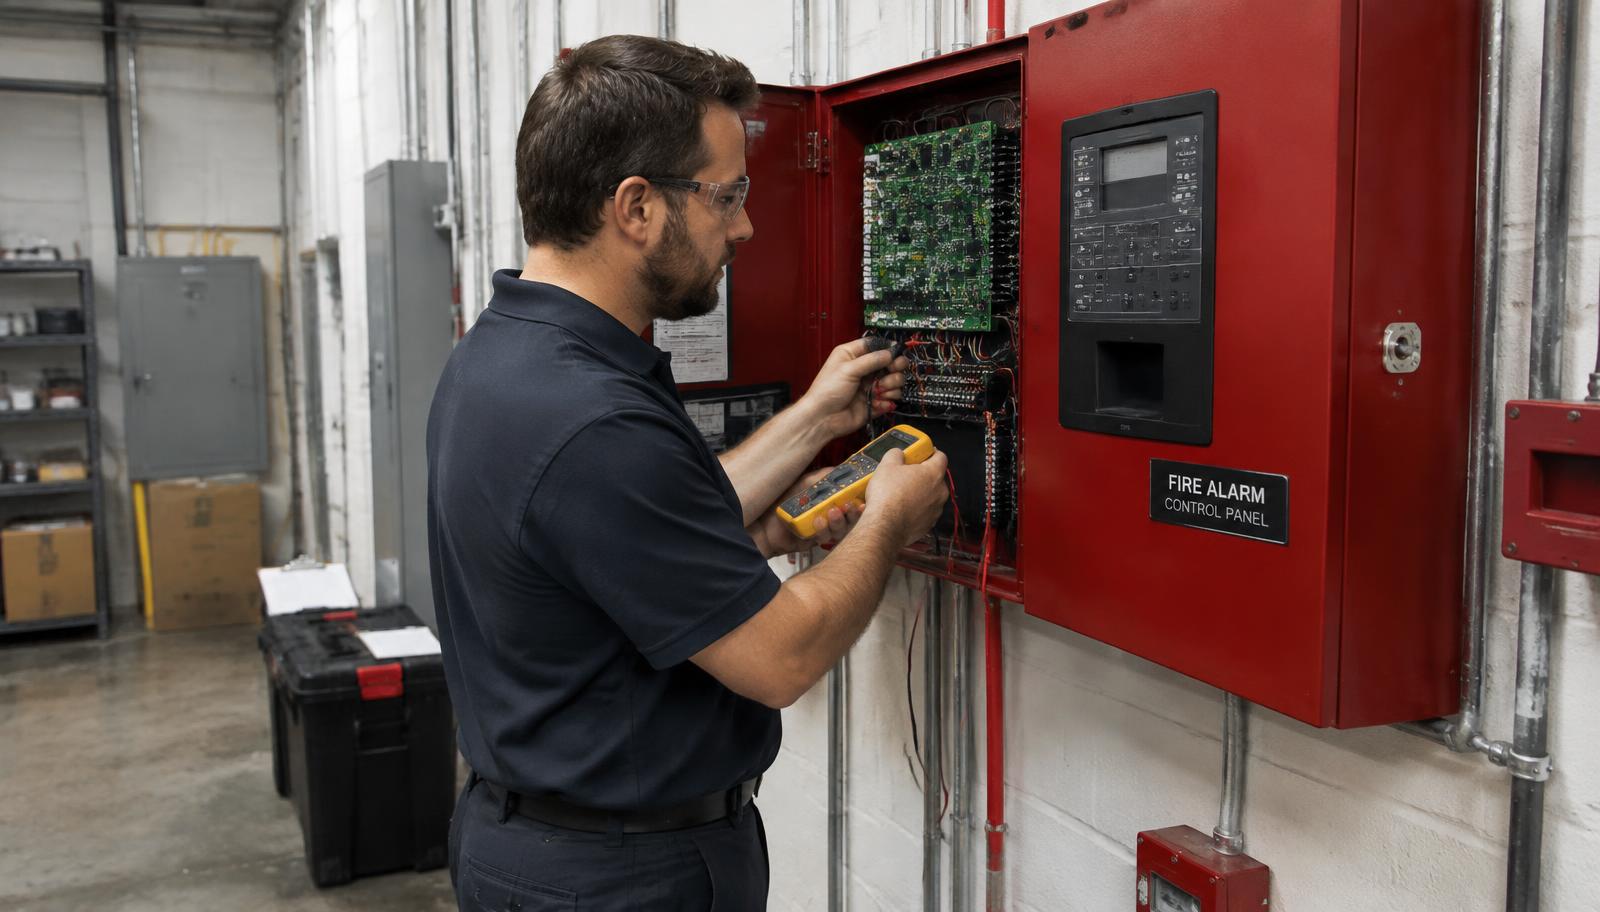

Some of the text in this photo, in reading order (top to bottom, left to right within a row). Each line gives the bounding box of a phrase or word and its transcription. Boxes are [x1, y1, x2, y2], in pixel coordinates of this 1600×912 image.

[1168, 474, 1265, 504] FIRE ALARM
[1164, 497, 1269, 527] CONTROL PANEL
